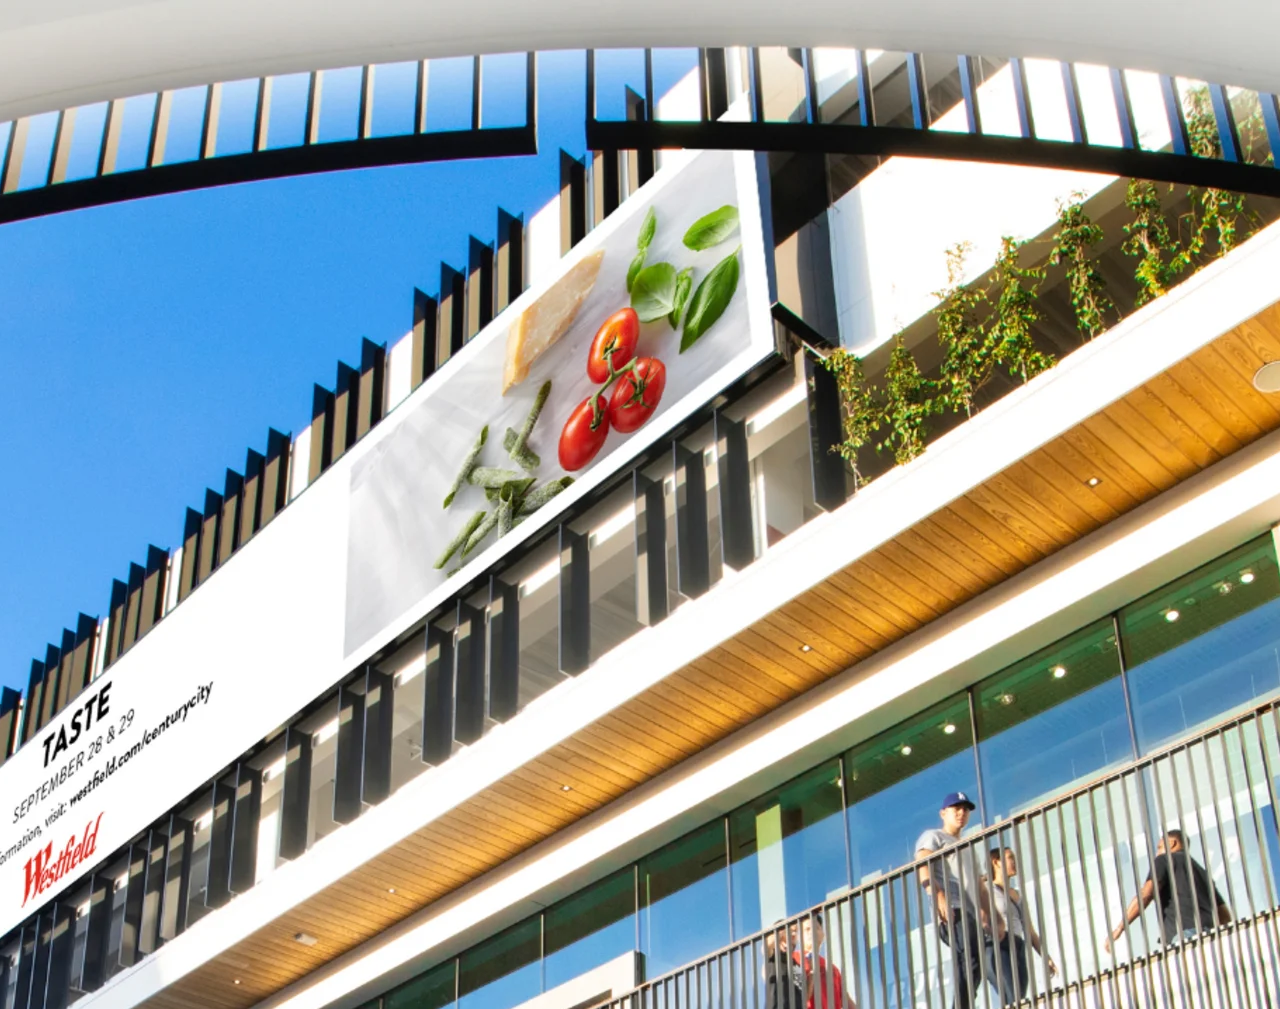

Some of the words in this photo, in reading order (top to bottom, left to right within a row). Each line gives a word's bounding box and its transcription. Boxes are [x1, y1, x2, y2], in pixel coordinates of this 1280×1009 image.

[13, 751, 85, 824] SEPTEMBER
[88, 736, 103, 761] 28
[107, 725, 115, 744] &
[119, 708, 135, 735] 29
[43, 681, 112, 768] TASTE
[45, 802, 68, 827] visit:
[70, 681, 214, 807] westfield.com/centurycity
[21, 811, 105, 908] Westfield
